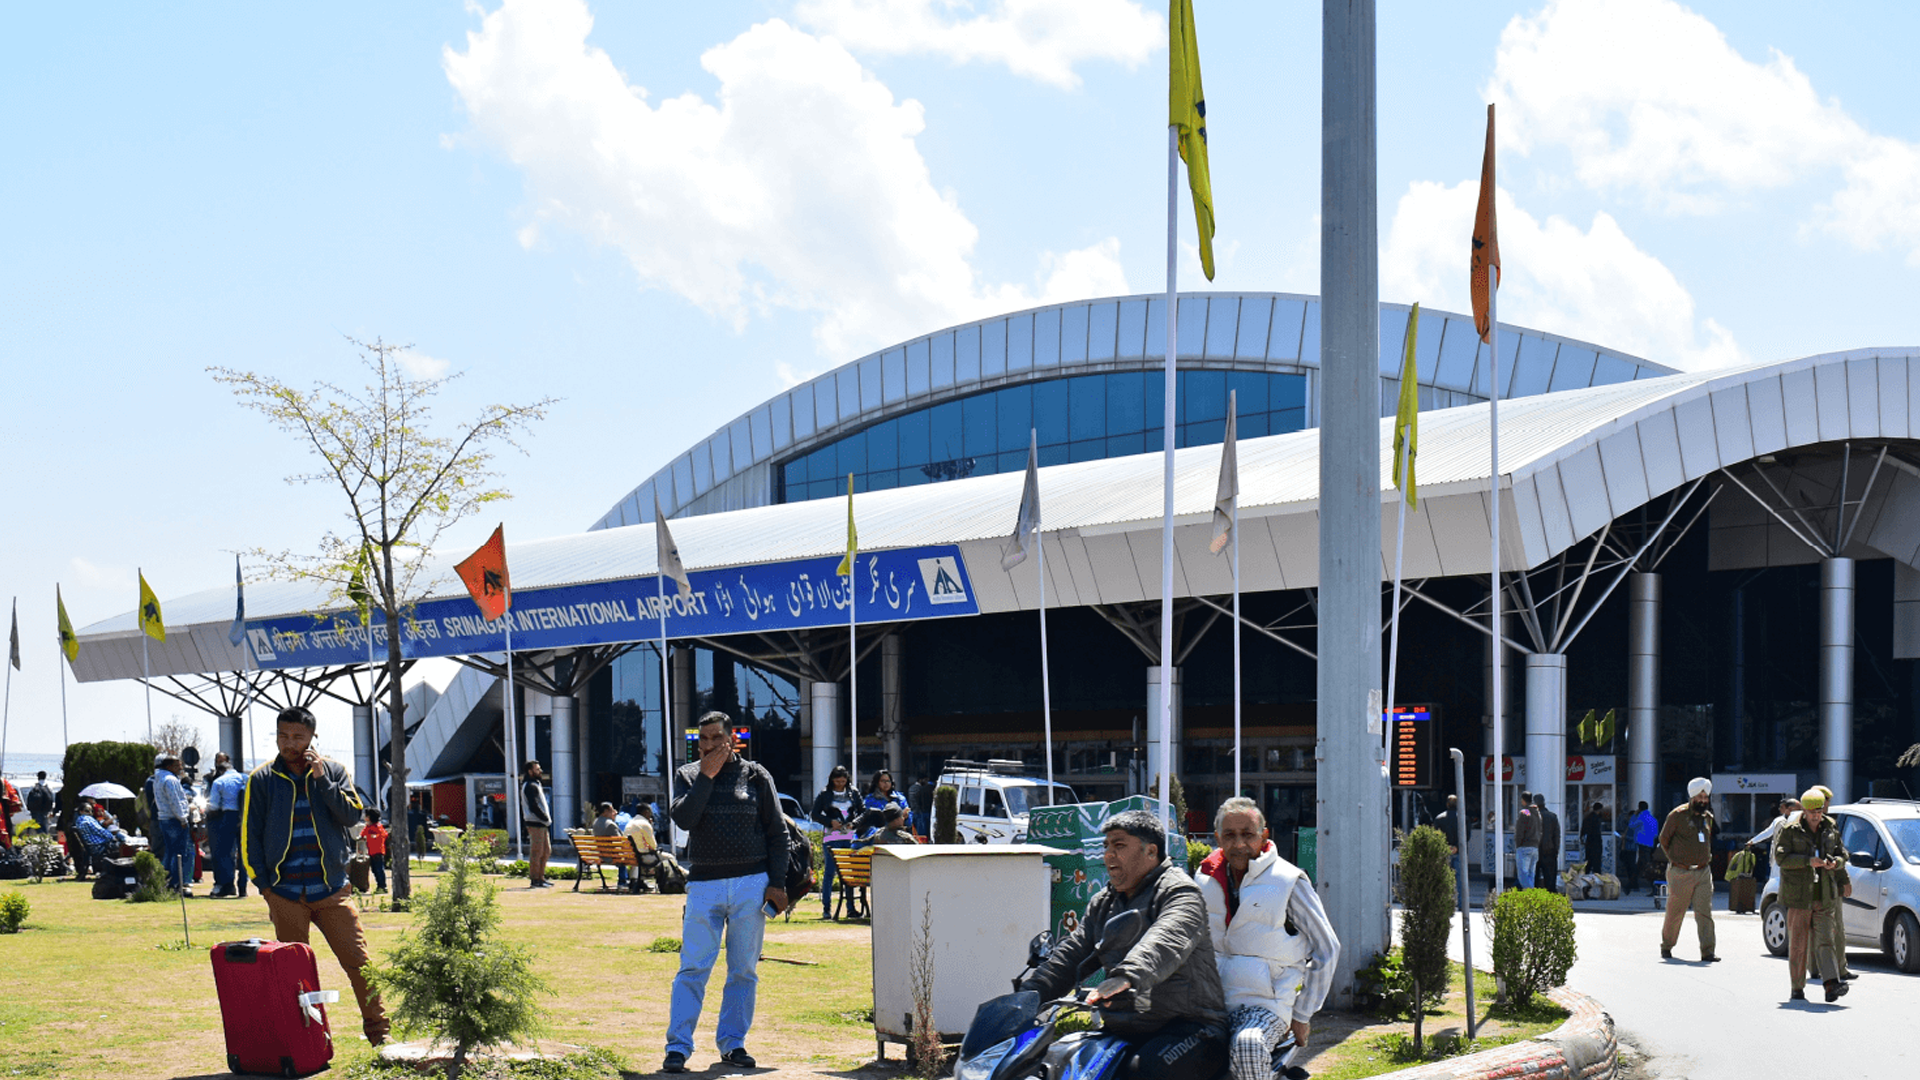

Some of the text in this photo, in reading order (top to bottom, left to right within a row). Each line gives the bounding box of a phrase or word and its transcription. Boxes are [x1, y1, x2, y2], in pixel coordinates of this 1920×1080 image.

[443, 591, 708, 638] SRINAGAR INTERNATIONAL AIRPORT
